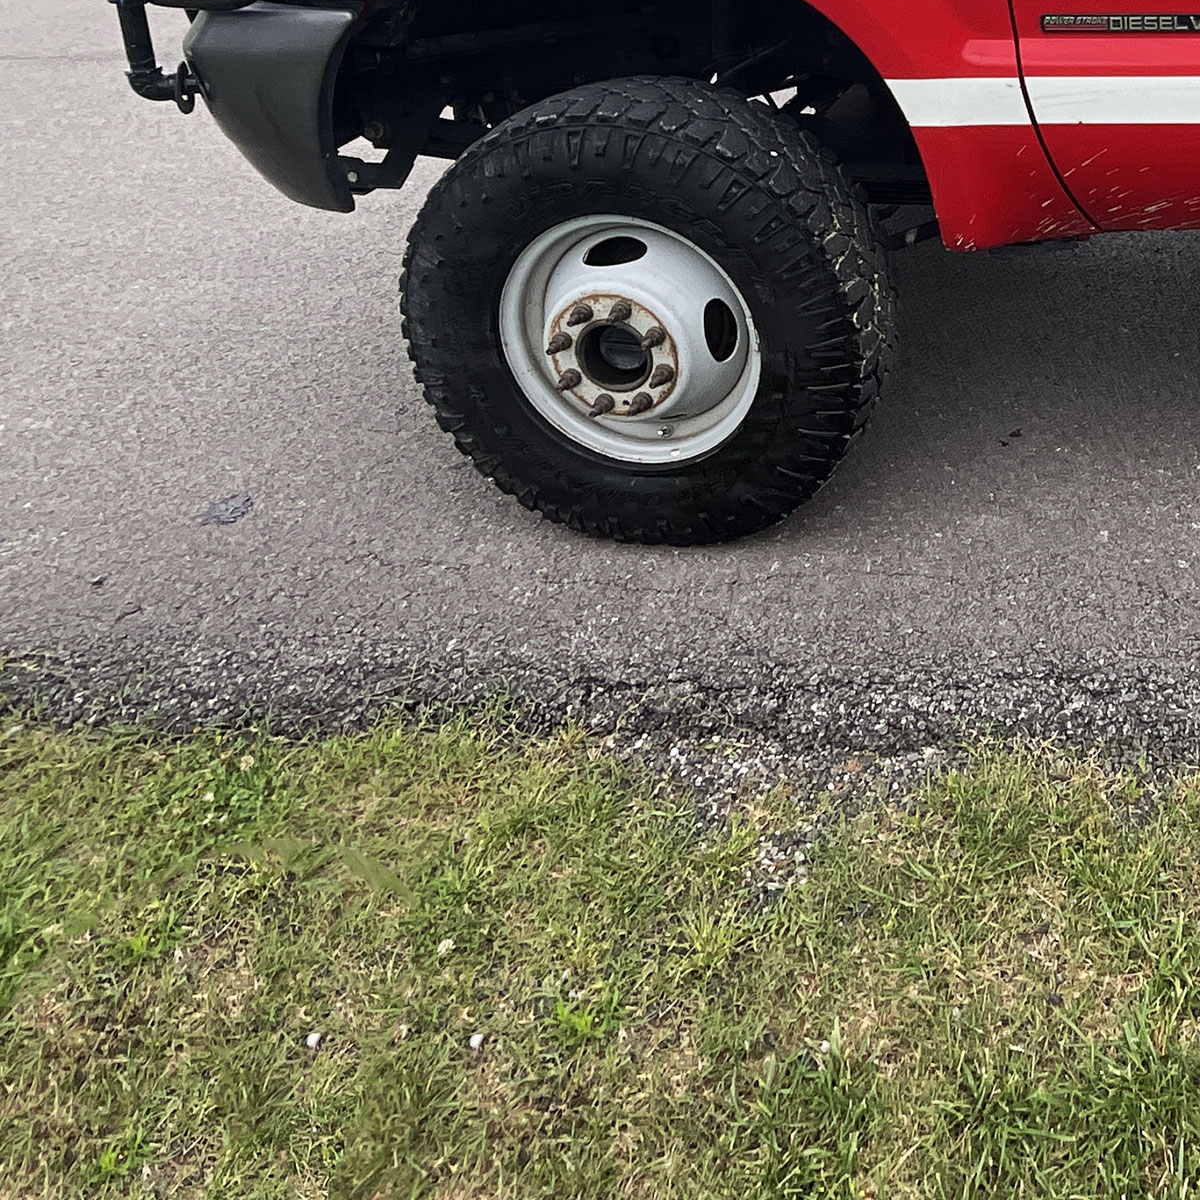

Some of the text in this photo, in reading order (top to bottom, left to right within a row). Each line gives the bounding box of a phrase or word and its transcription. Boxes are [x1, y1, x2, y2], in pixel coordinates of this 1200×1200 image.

[1044, 16, 1075, 25] POWER
[1076, 16, 1108, 25] STROKE
[1109, 16, 1188, 31] DIESEL
